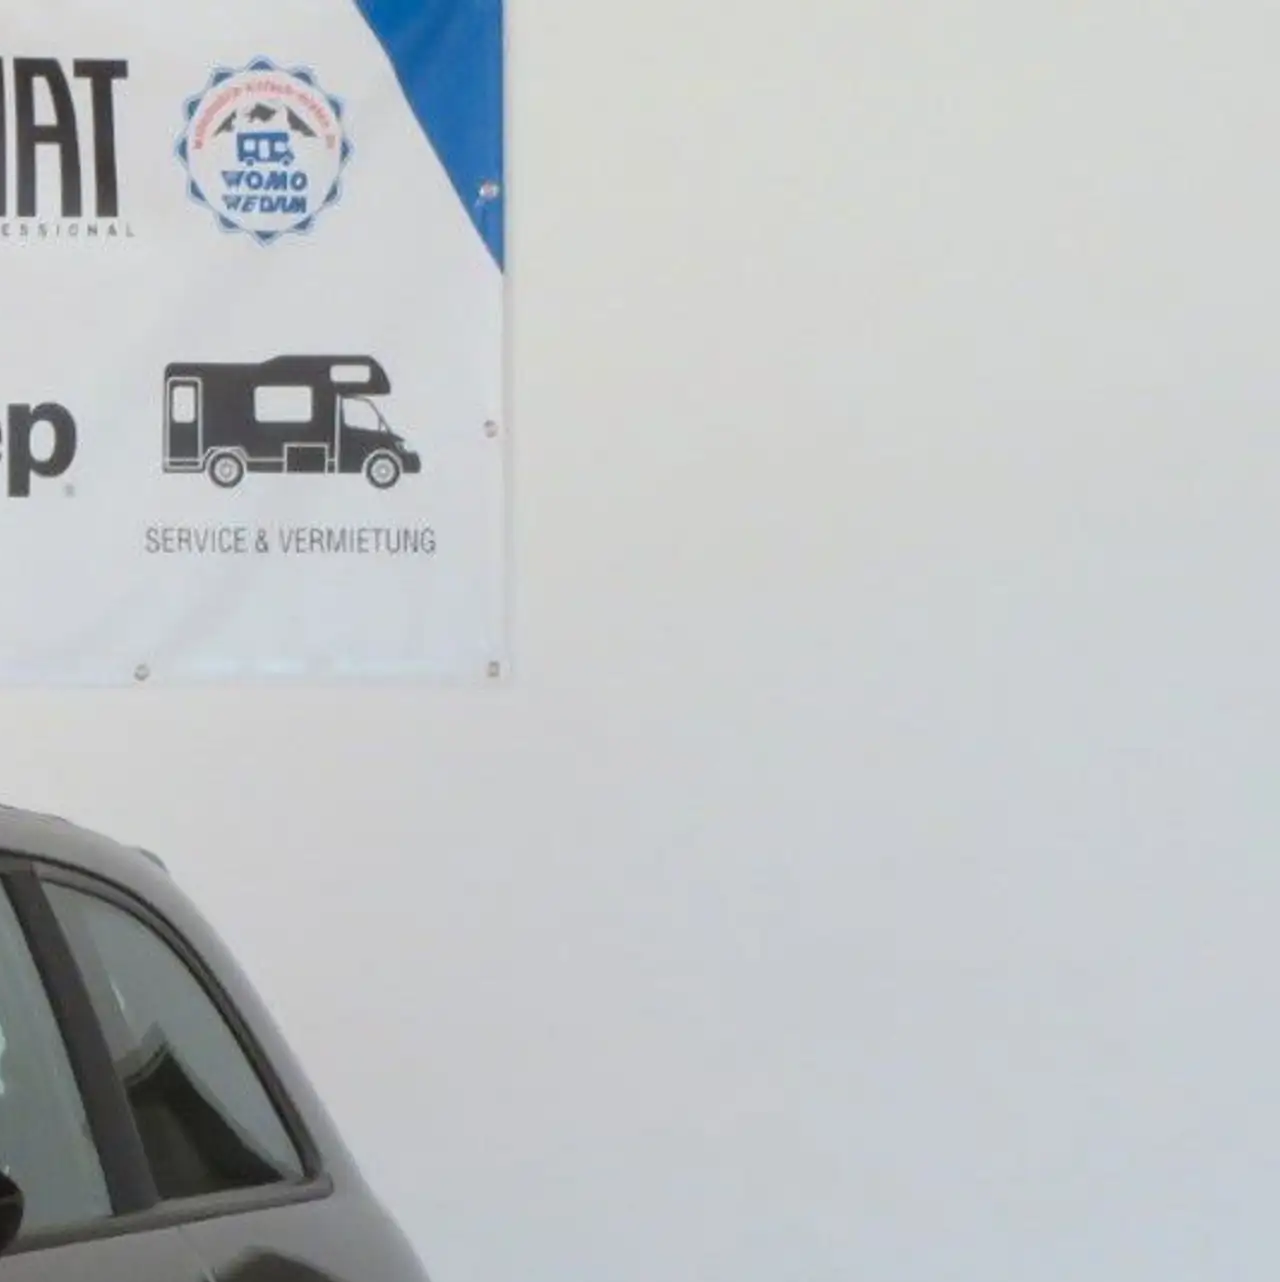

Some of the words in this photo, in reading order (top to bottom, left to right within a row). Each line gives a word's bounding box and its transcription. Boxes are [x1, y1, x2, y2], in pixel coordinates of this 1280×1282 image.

[221, 170, 308, 191] WOMO
[144, 526, 248, 554] SERVICE
[254, 528, 270, 554] &
[278, 527, 437, 556] VERMIETUNG
